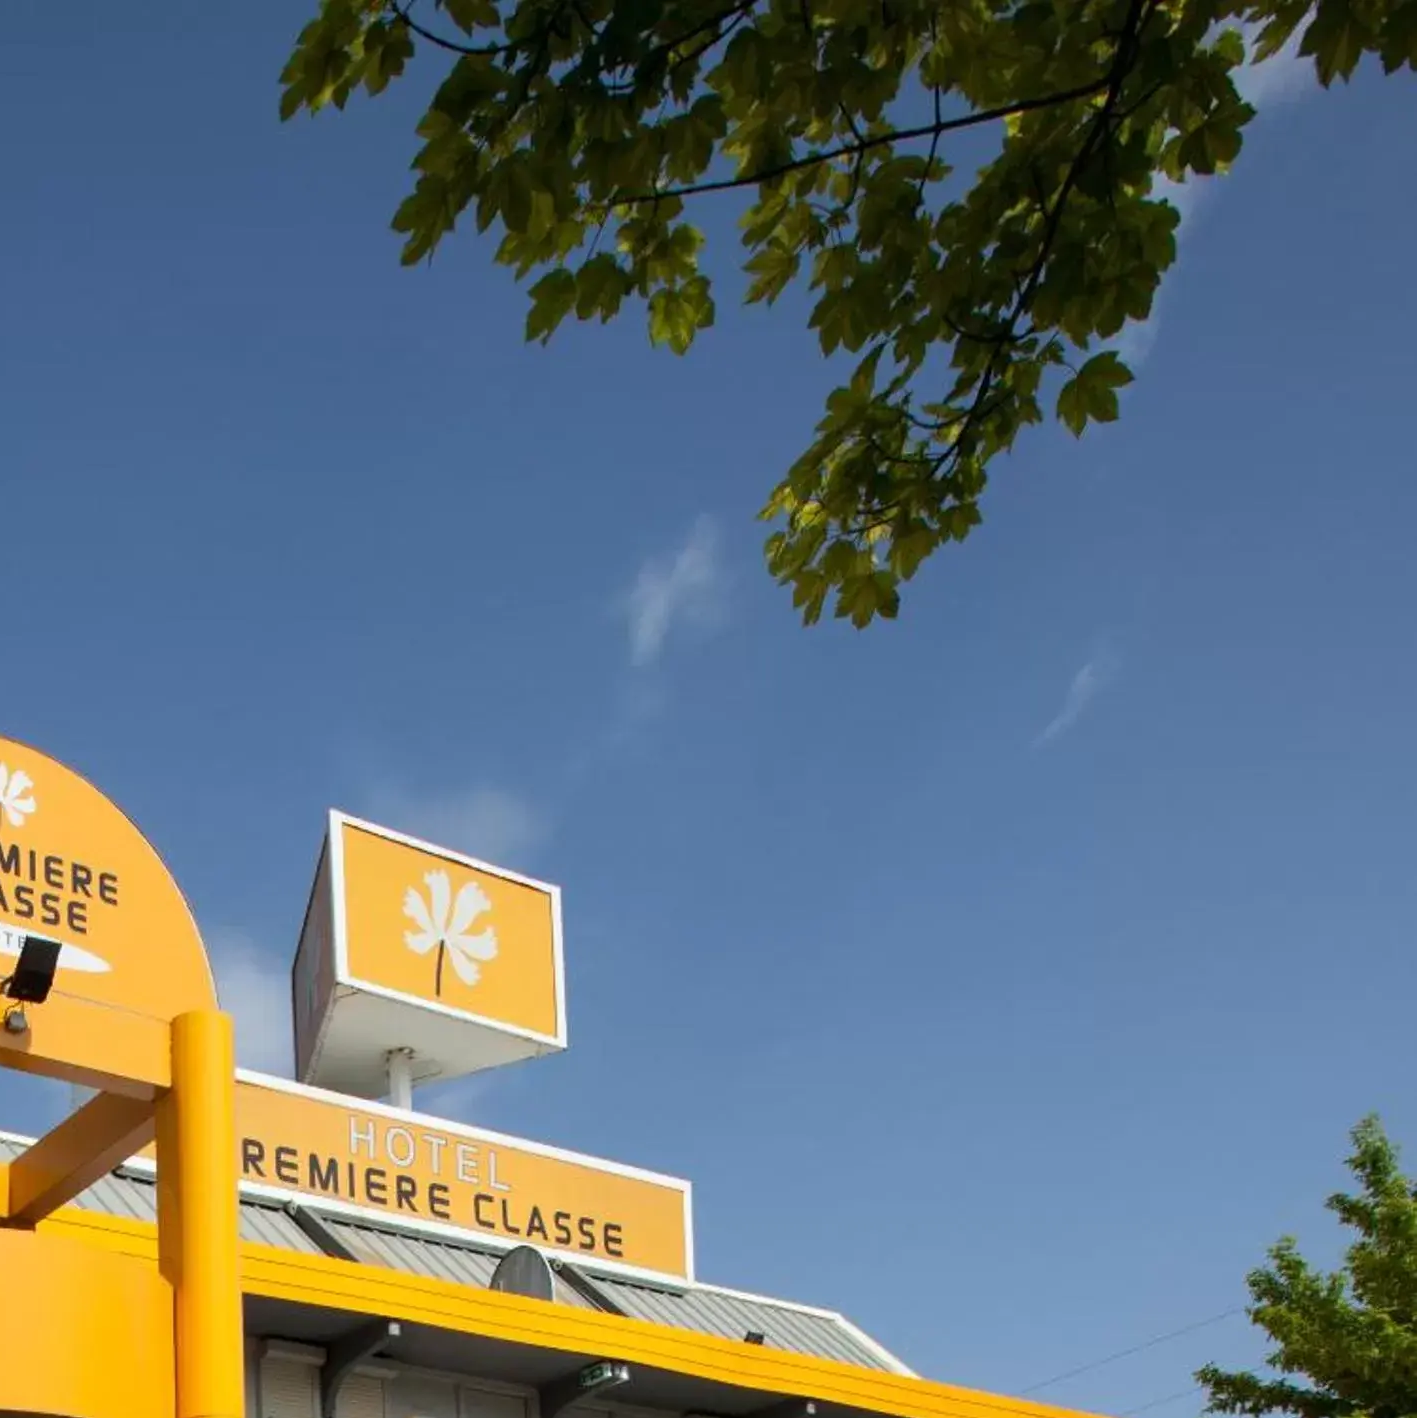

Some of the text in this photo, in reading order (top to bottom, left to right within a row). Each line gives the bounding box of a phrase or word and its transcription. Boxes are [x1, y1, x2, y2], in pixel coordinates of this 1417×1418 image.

[241, 1137, 624, 1258] REMIERE CLASSE
[348, 1115, 510, 1192] HOTEL
